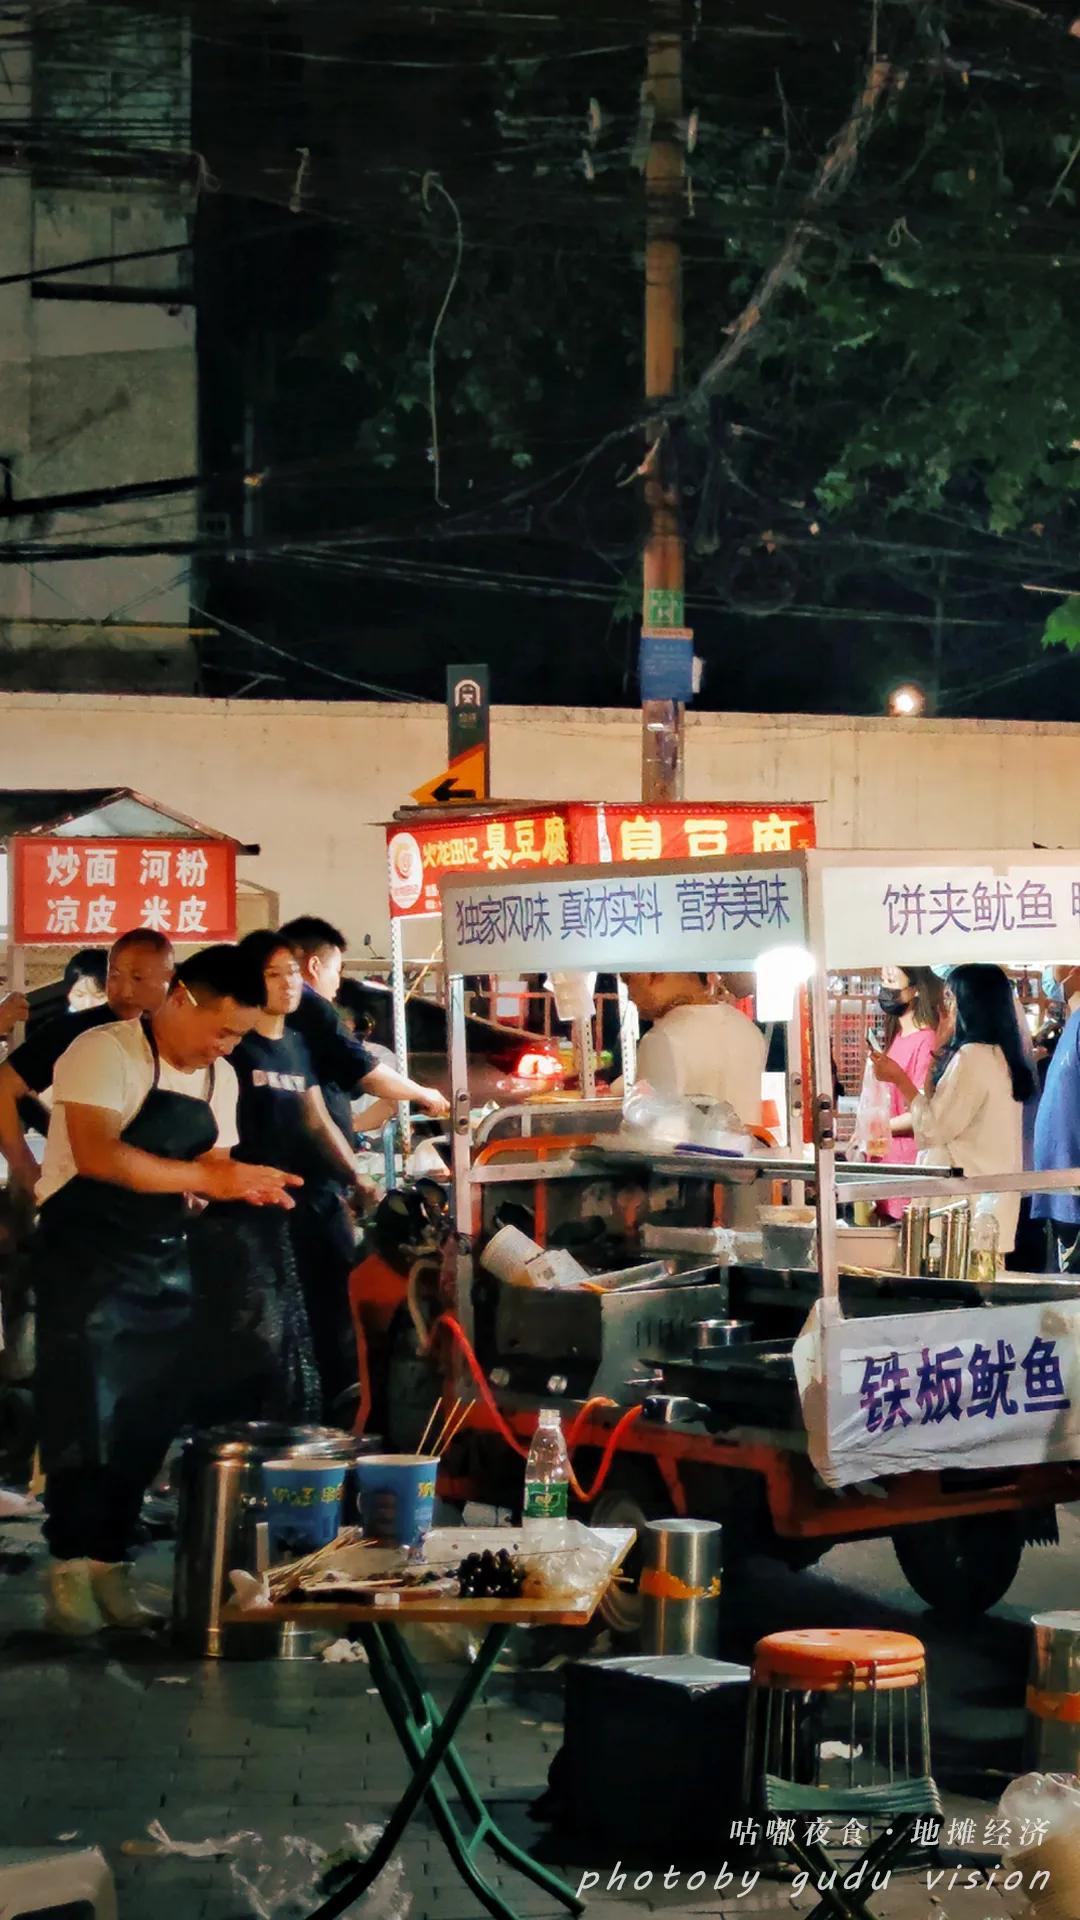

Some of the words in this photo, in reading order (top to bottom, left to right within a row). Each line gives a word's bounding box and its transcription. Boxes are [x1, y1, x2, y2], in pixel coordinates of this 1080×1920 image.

[46, 846, 118, 887] 炒面
[139, 848, 209, 887] 河粉
[483, 815, 569, 870] 臭豆腐
[46, 895, 118, 934] 凉皮
[140, 895, 209, 934] 米皮
[456, 891, 552, 946] 独家风味
[558, 882, 663, 940] 真材实料
[675, 873, 790, 932] 营养美味
[882, 879, 1057, 936] 饼夹鱿鱼
[860, 1336, 1071, 1433] 铁板鱿鱼
